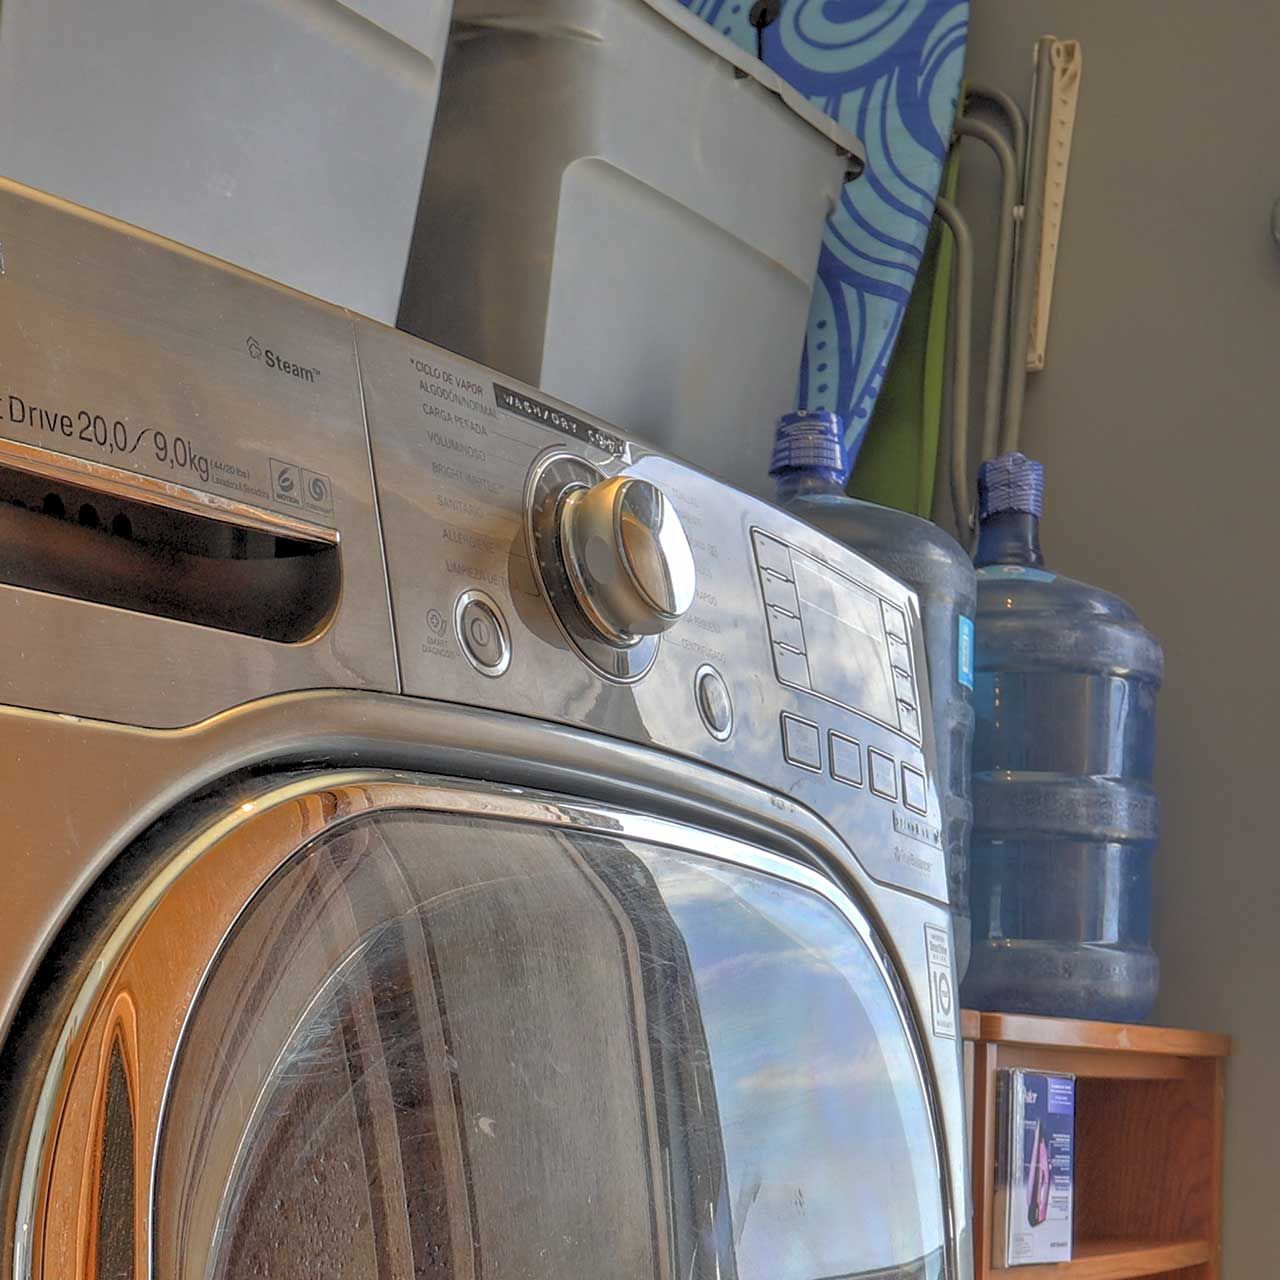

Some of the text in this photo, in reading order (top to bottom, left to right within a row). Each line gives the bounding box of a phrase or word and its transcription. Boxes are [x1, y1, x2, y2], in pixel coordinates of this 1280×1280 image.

[441, 370, 454, 385] DE
[454, 377, 484, 398] VAPOR
[8, 395, 74, 437] Drive
[422, 402, 454, 425] CARGA
[426, 430, 487, 462] VOLUMINOSO
